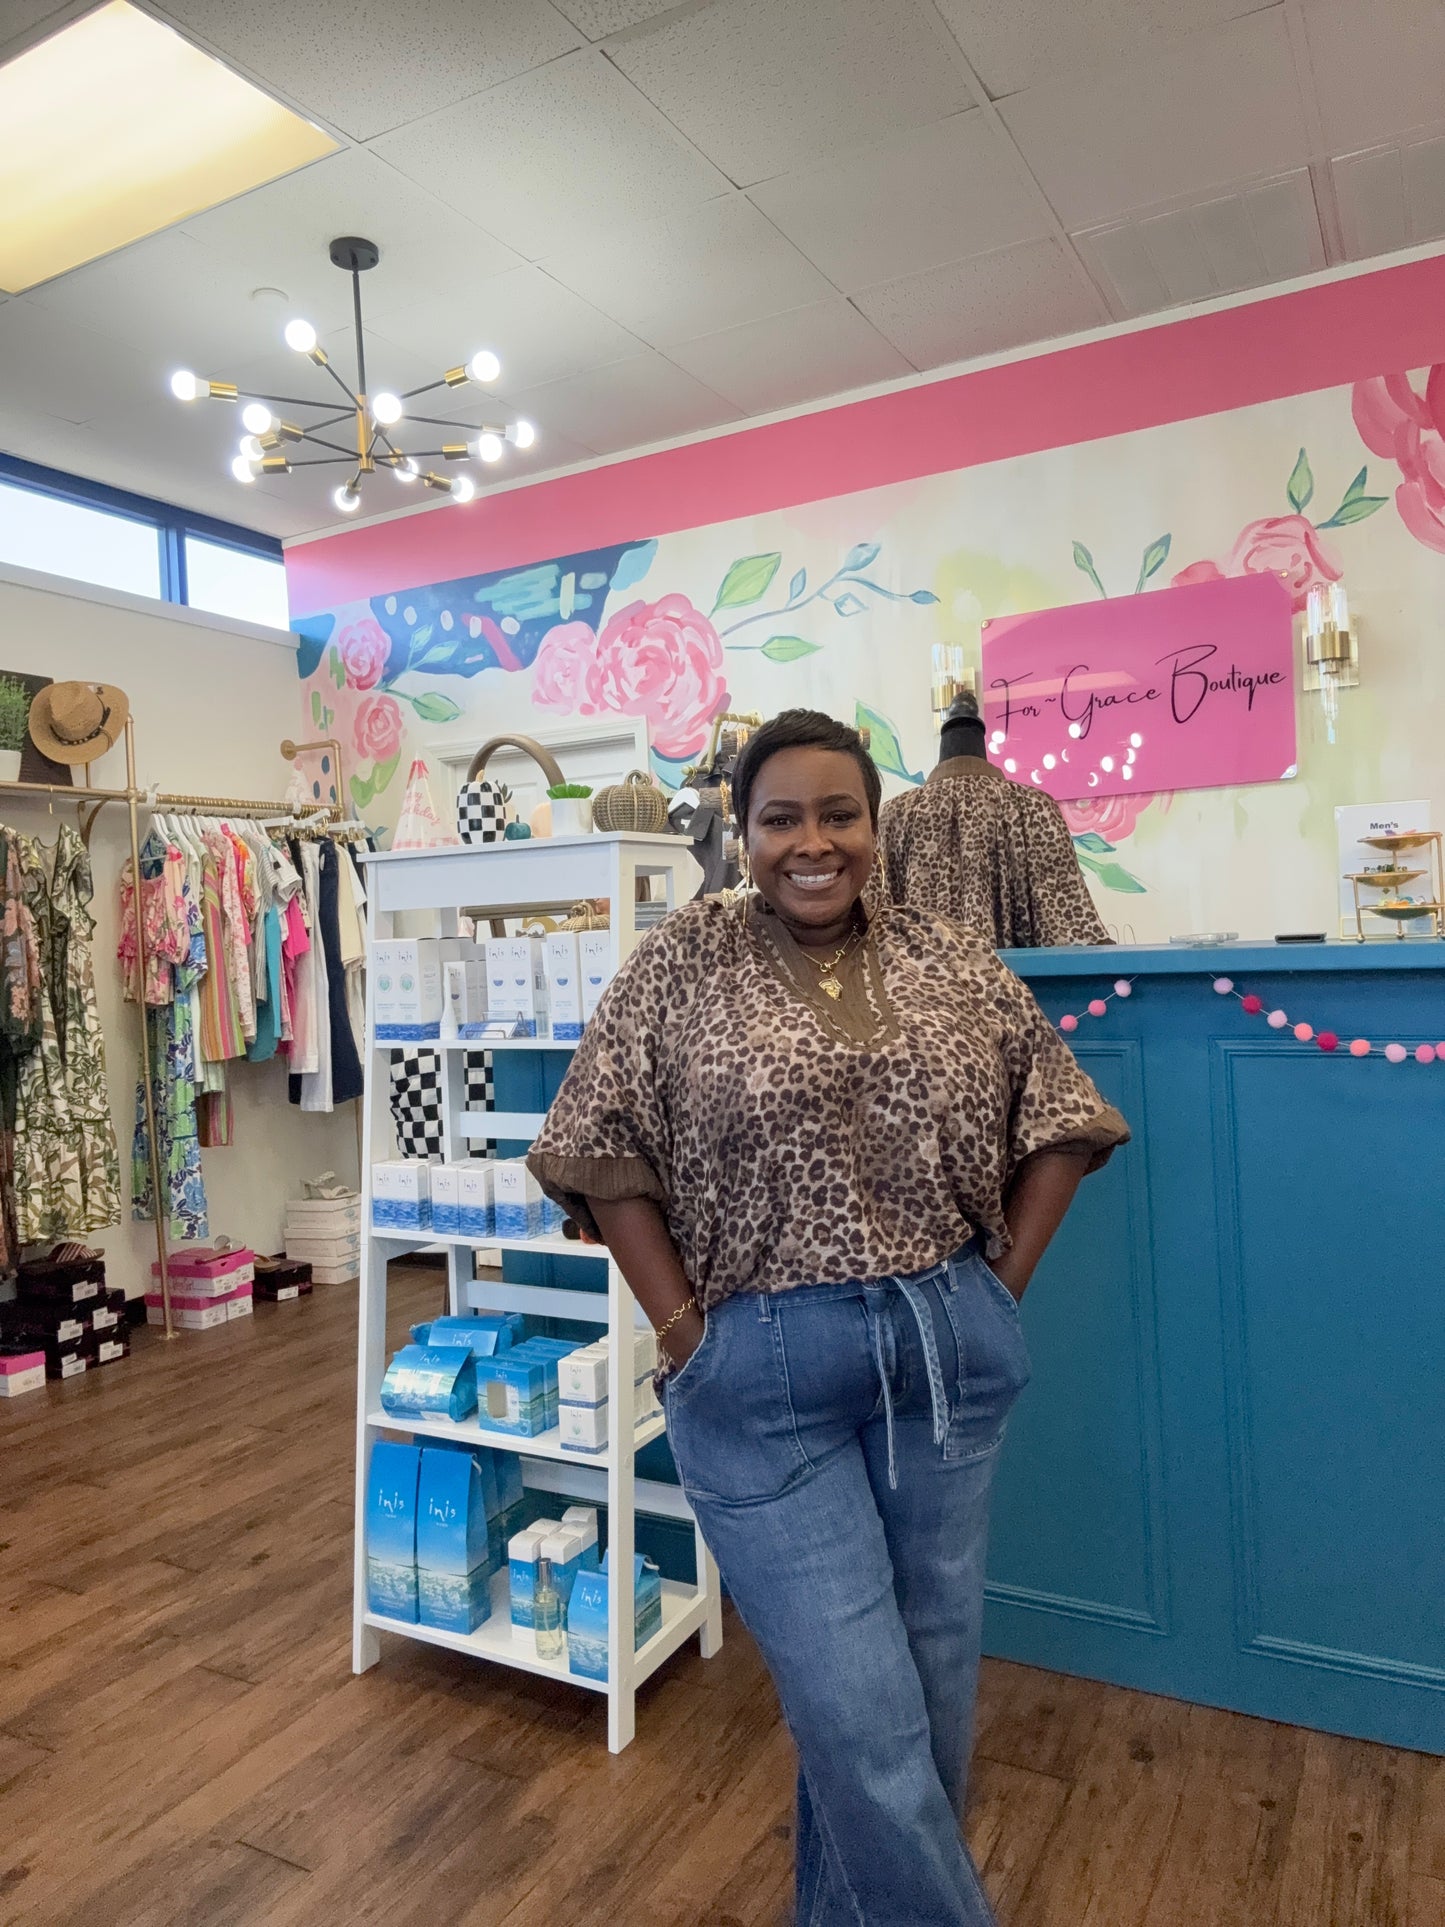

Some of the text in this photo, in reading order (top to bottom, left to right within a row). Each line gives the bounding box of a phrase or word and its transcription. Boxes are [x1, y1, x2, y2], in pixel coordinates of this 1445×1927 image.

[1155, 644, 1287, 724] Boutique
[1369, 821, 1399, 830] Men's
[552, 944, 568, 957] inis
[585, 943, 603, 956] inis
[378, 1488, 405, 1513] inis
[429, 1497, 456, 1522] inis
[580, 1587, 602, 1606] inis
